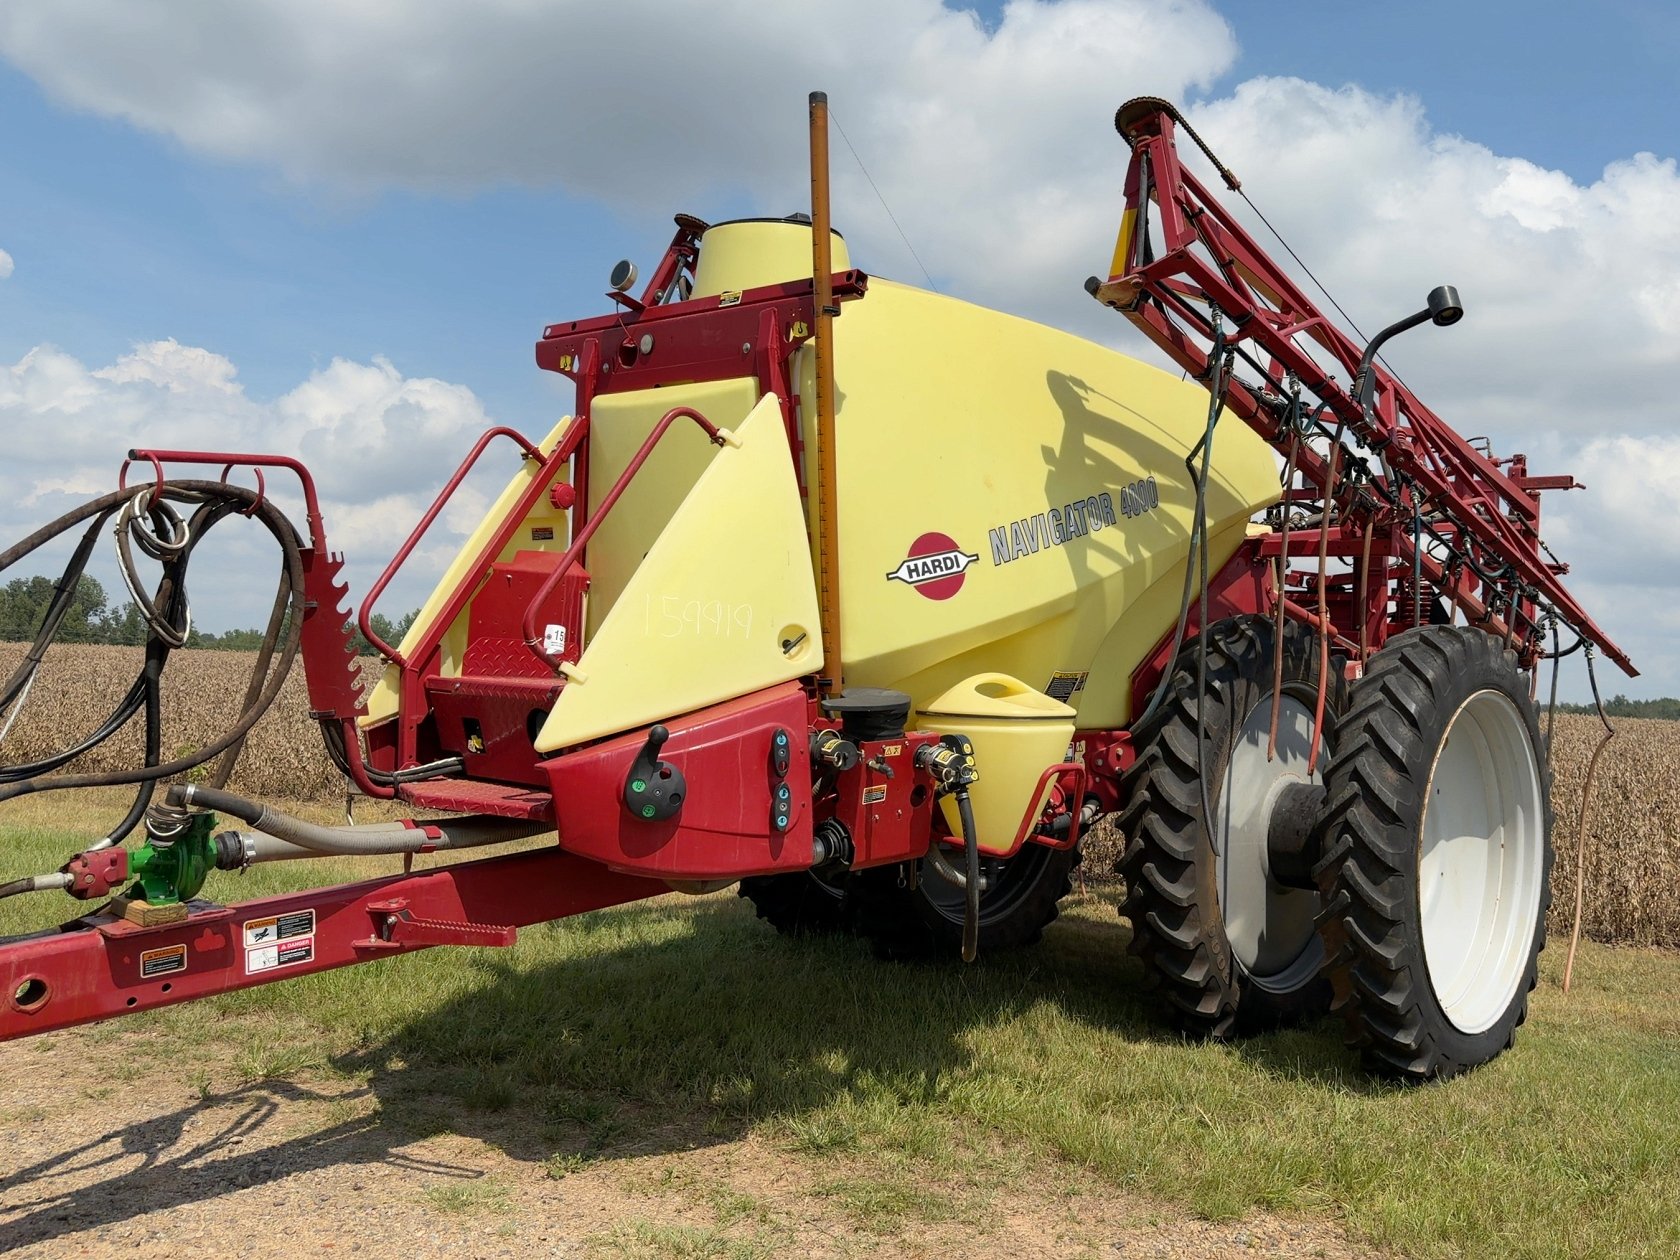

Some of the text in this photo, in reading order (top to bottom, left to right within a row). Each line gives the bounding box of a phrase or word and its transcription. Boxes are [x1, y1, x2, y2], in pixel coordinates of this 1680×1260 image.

[988, 475, 1159, 567] NAVIGATOR 4000
[906, 555, 961, 580] HARDI
[554, 630, 564, 642] 15
[287, 940, 310, 949] DANGER
